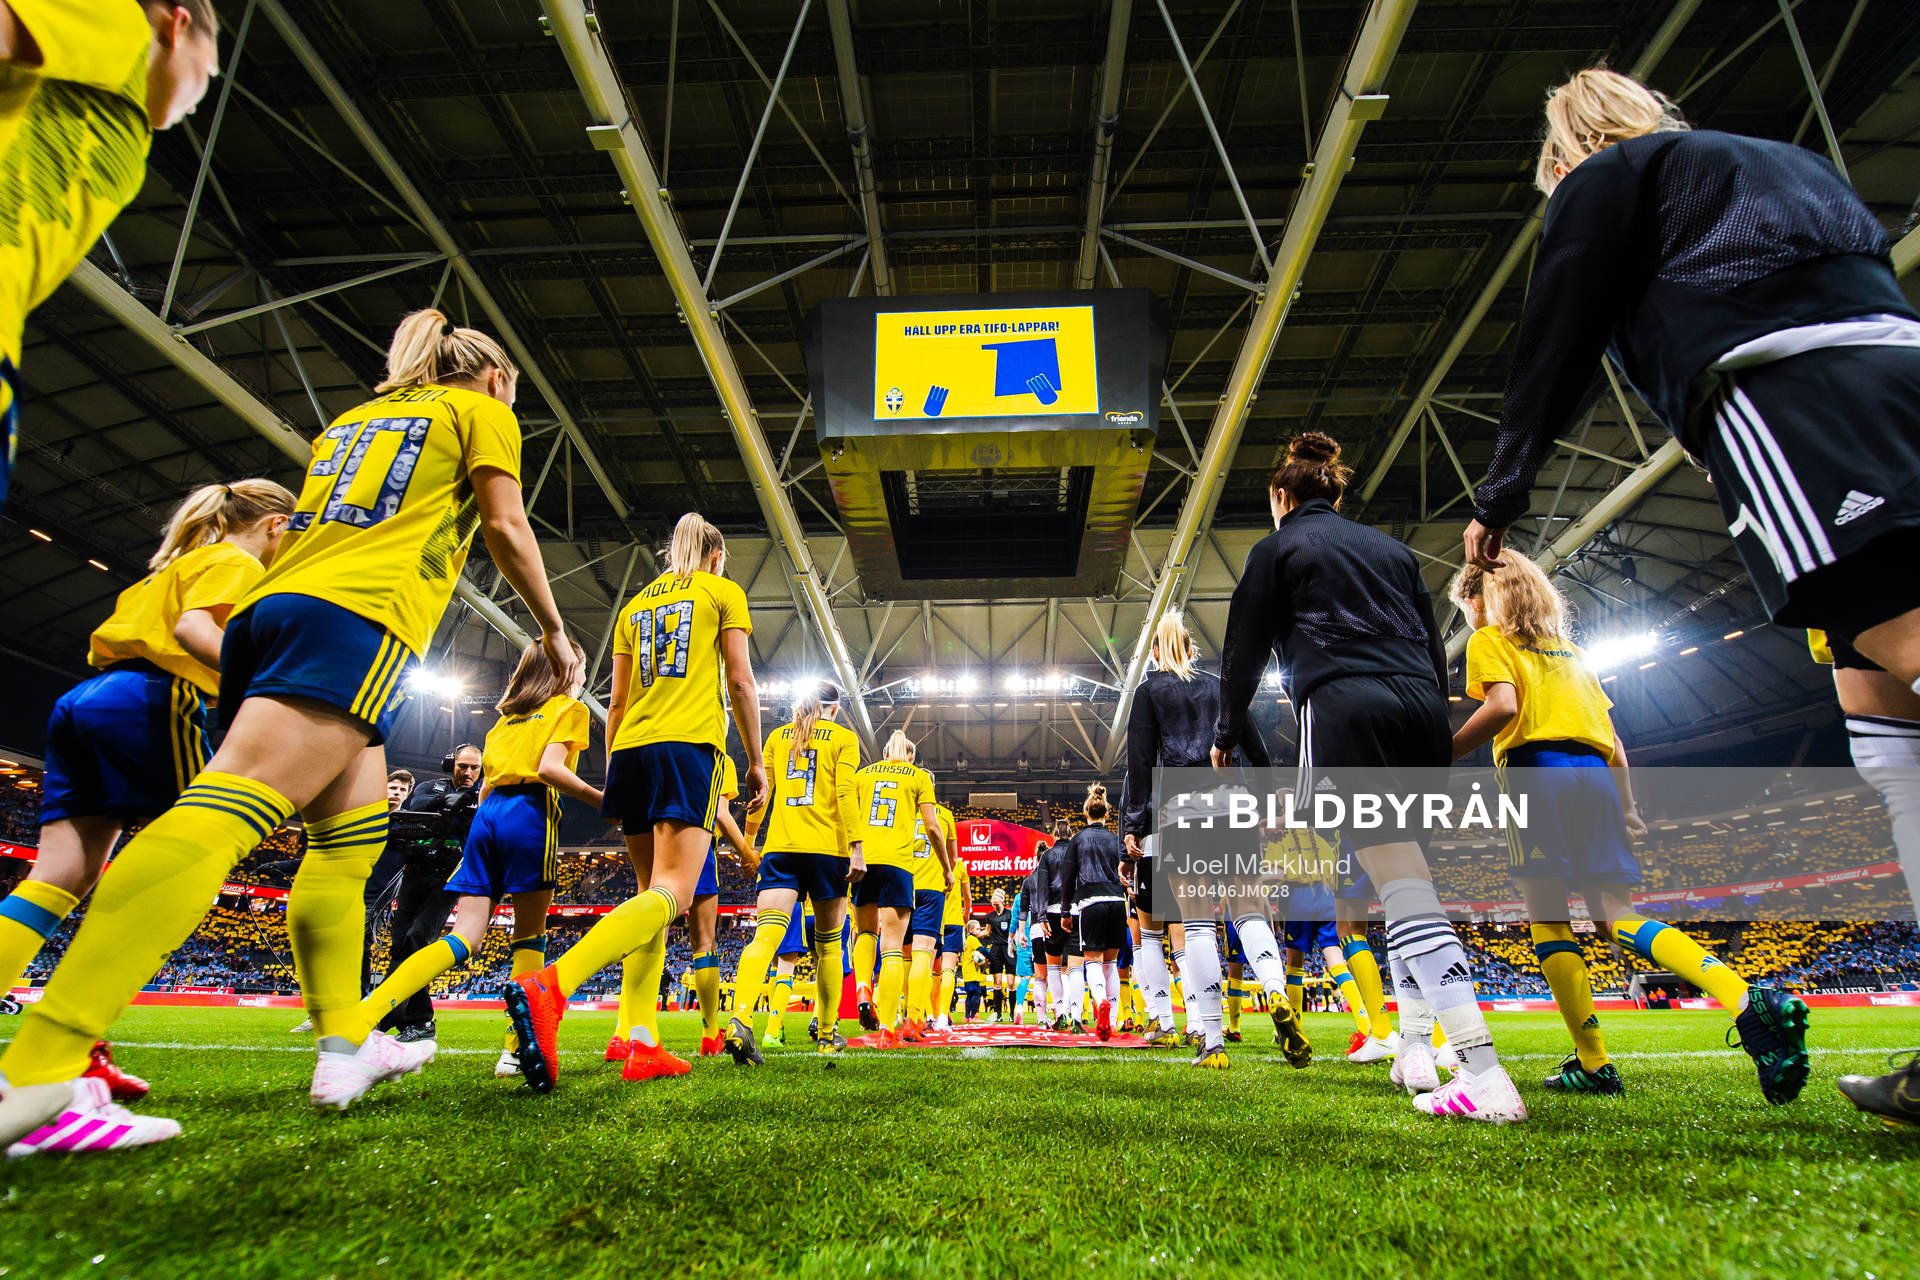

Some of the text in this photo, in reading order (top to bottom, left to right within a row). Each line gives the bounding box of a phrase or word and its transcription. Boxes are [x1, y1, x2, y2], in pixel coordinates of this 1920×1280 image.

[934, 324, 957, 335] UPP
[959, 323, 981, 334] ERA
[984, 321, 1059, 333] TIFO-LAPPAR!
[630, 600, 694, 688] 18
[786, 749, 818, 807] 9
[865, 765, 916, 777] ERIKSSON
[869, 780, 898, 828] 6
[970, 856, 1012, 871] svensk
